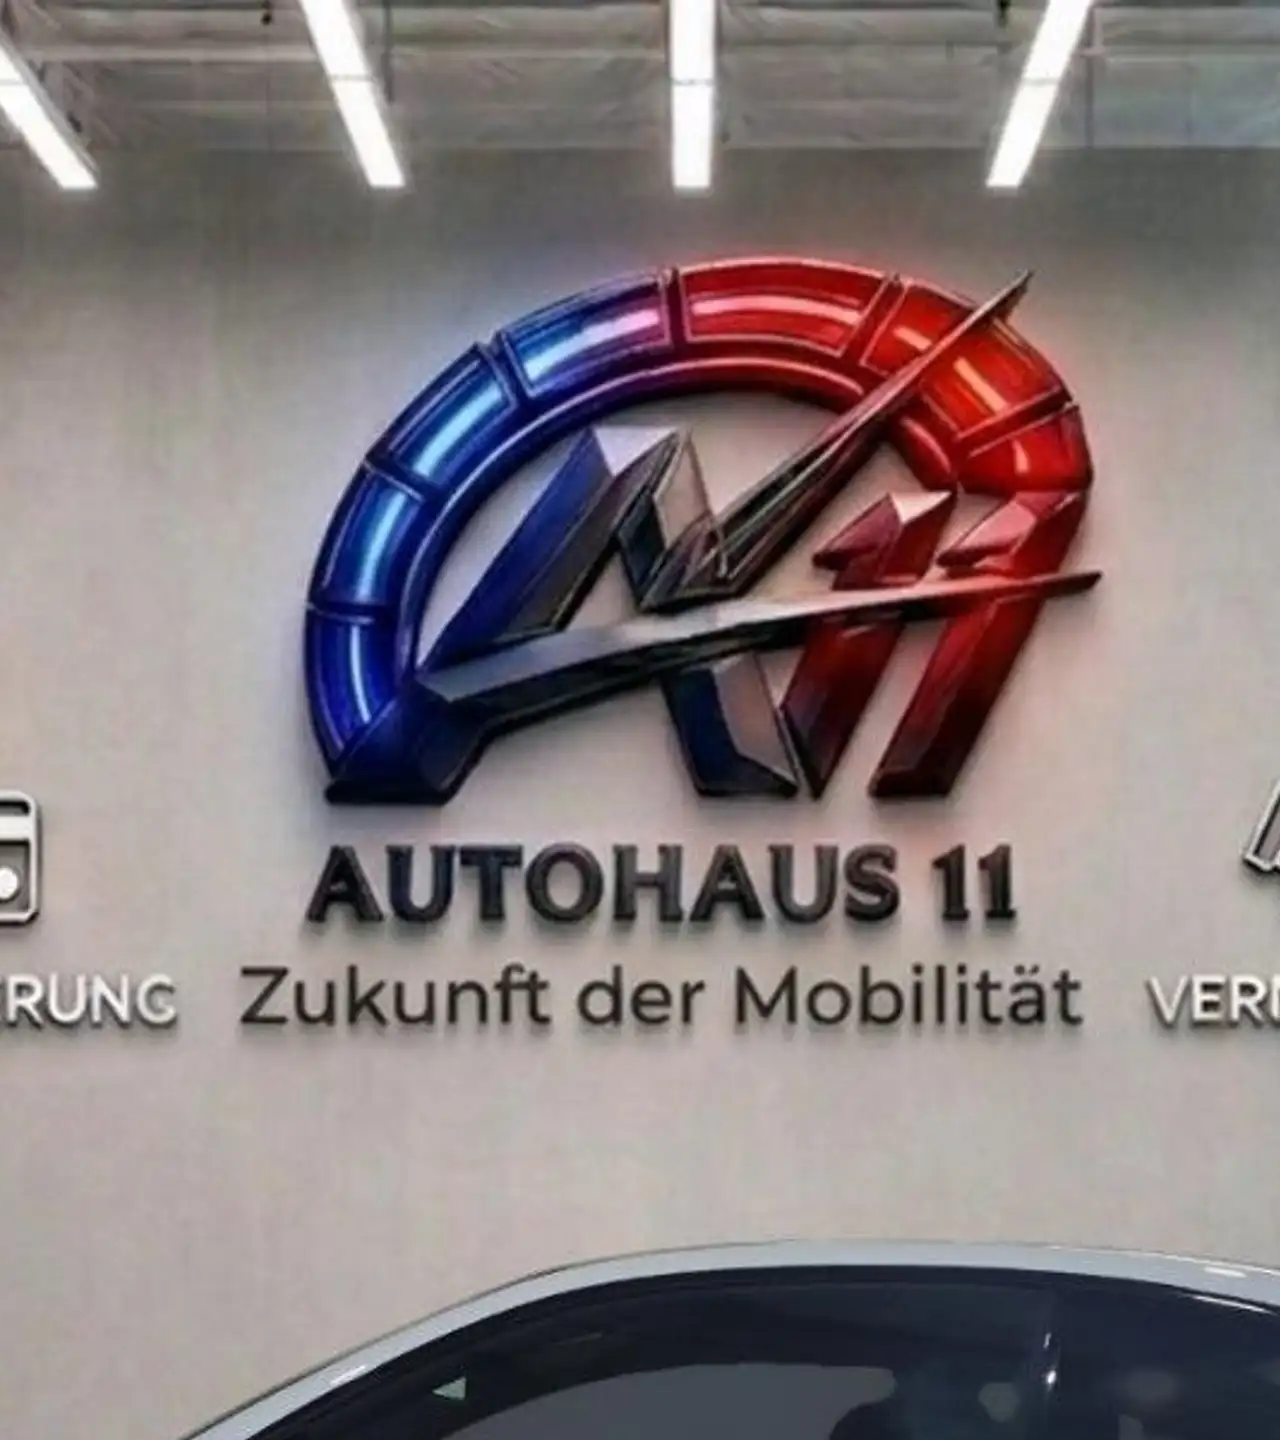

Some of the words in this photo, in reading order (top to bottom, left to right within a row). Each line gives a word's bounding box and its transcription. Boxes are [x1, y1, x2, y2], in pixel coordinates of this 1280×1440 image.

[306, 844, 900, 922] AUTOHAUS
[931, 844, 1018, 922] 11
[239, 964, 552, 1026] Zukunft
[576, 964, 706, 1026] der
[734, 964, 1084, 1026] Mobilität
